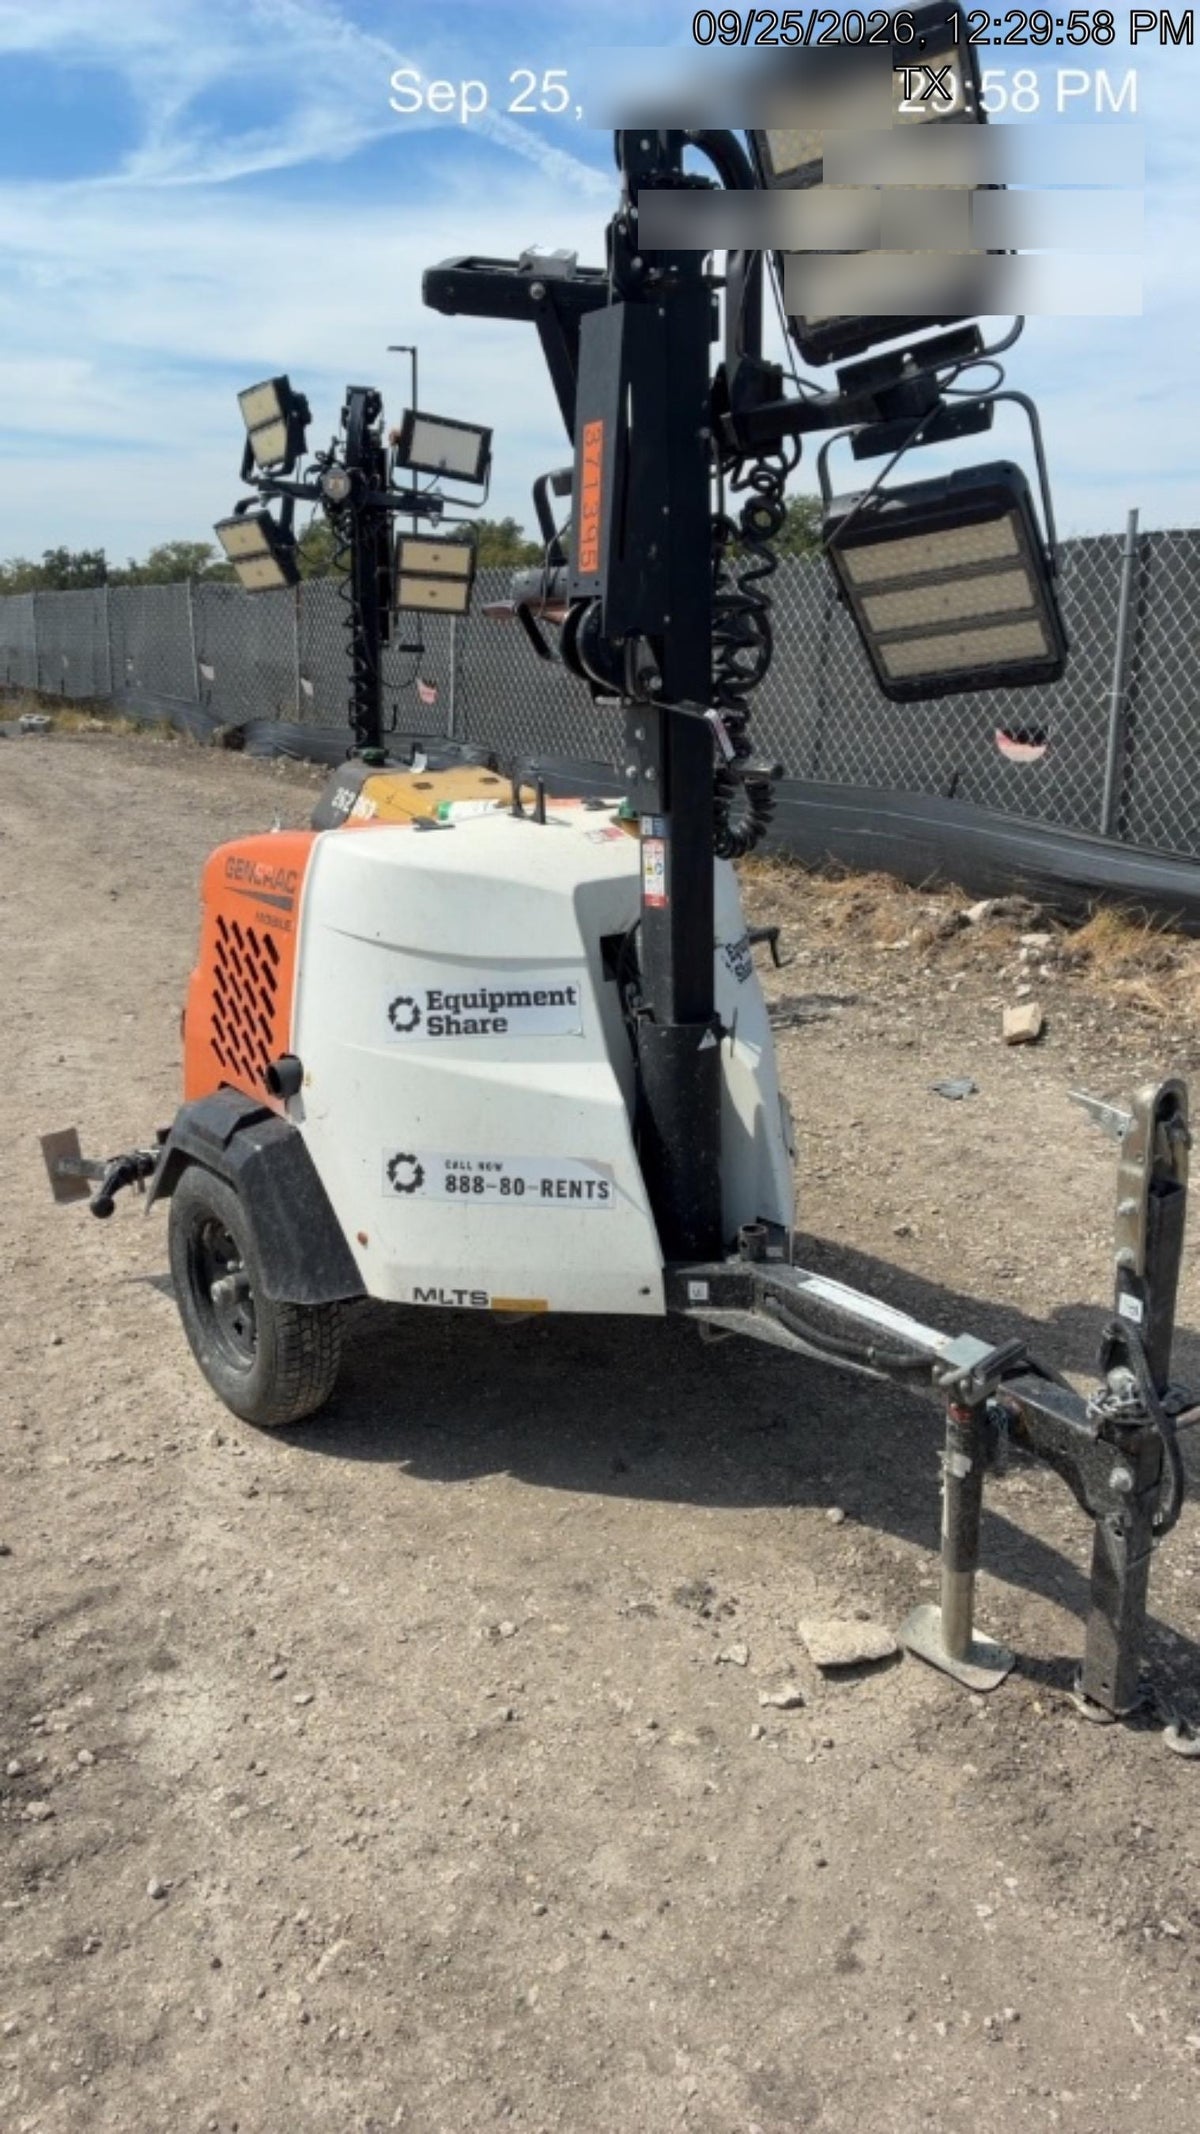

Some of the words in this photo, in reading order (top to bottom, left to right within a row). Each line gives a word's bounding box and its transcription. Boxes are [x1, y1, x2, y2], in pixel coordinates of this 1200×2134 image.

[580, 427, 601, 568] 371395
[425, 985, 577, 1014] Equipment
[426, 1015, 508, 1036] Share
[445, 1159, 473, 1170] CALL
[478, 1160, 504, 1172] NOW
[445, 1175, 610, 1199] 888-80-RENTS
[412, 1286, 490, 1306] MLTS
